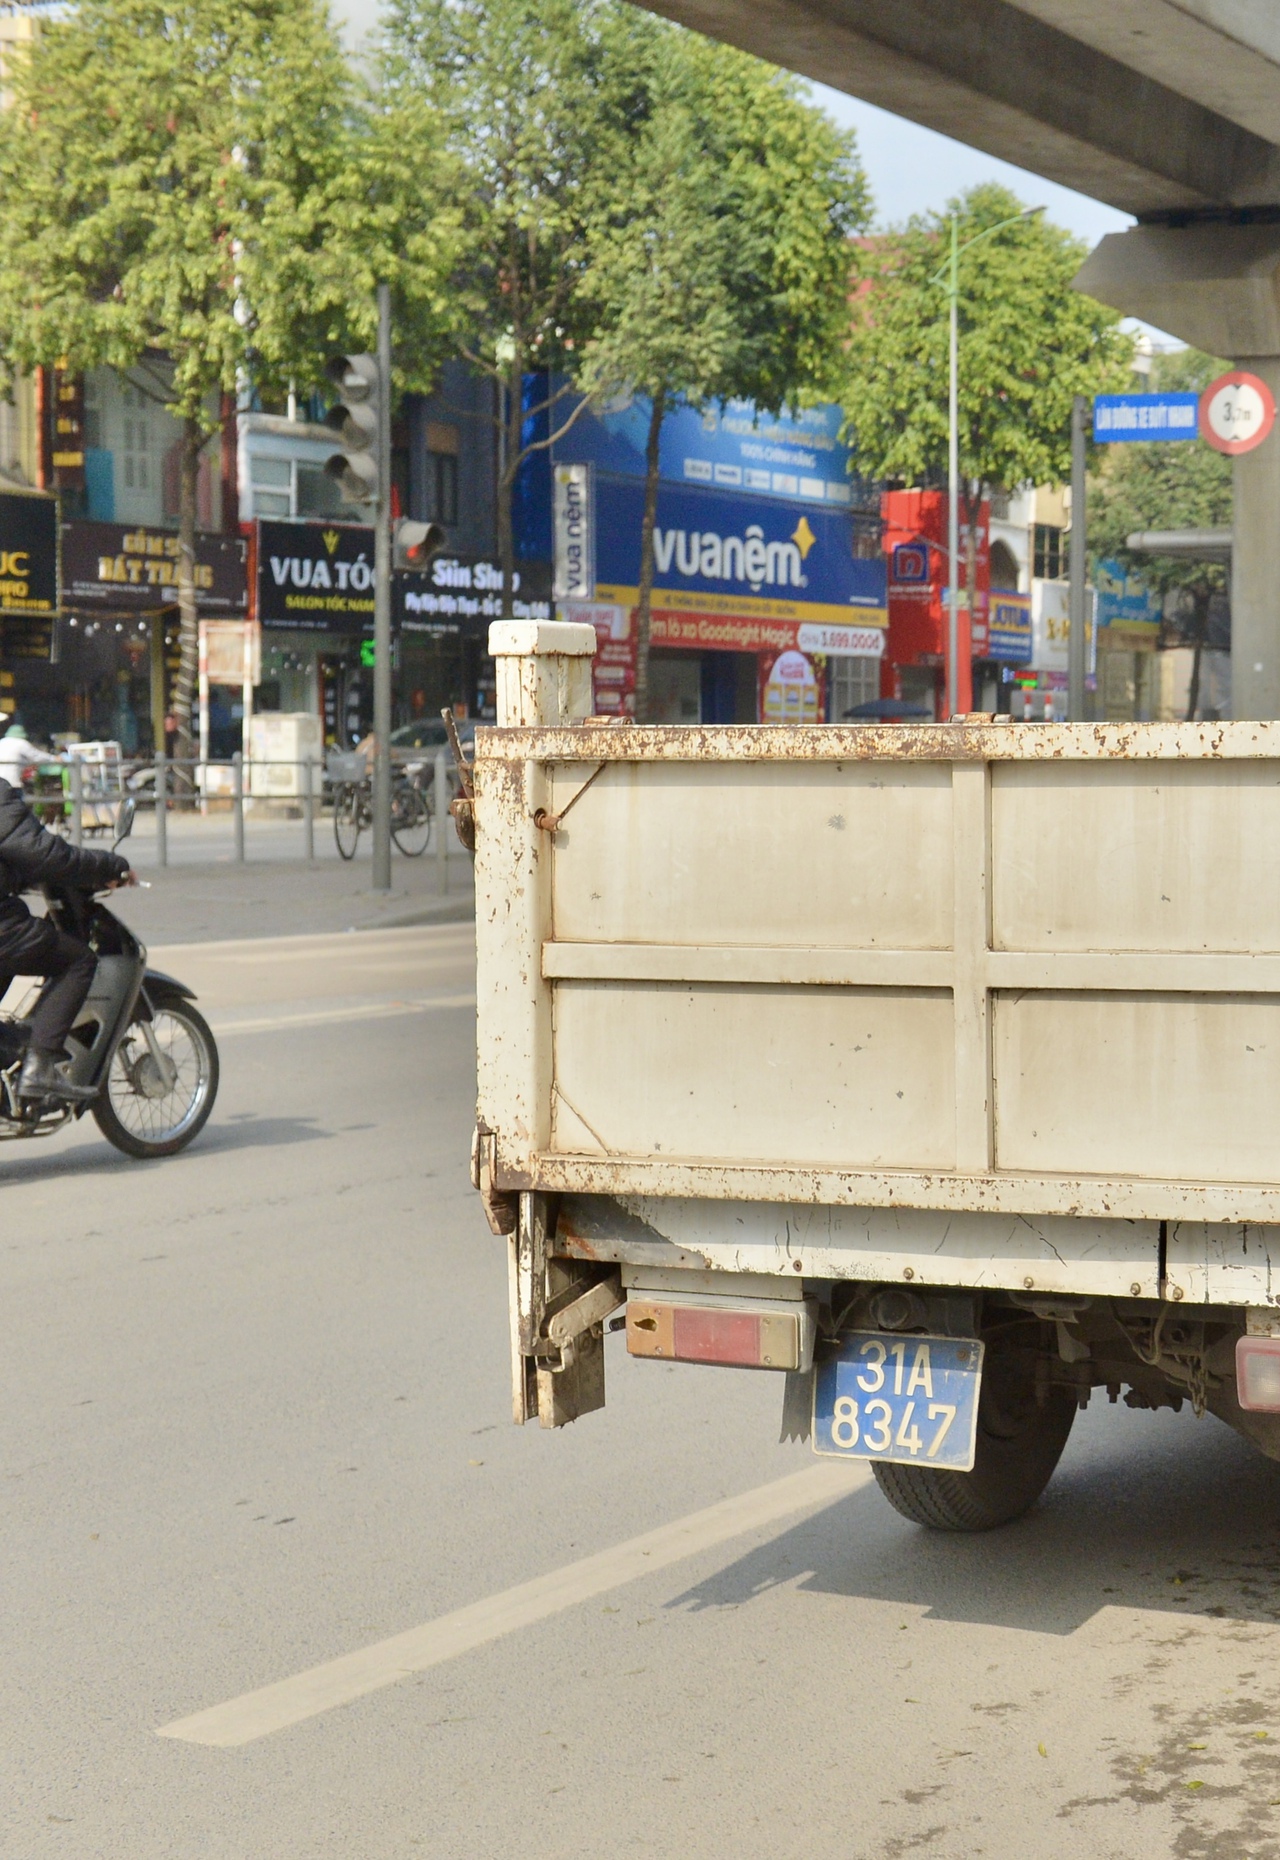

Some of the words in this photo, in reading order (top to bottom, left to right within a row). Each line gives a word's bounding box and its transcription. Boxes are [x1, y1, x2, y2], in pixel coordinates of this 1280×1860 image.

[98, 554, 143, 583] BÁT
[270, 555, 332, 588] VUA
[334, 553, 376, 591] TÓ
[567, 544, 582, 590] vua
[285, 594, 325, 610] SALON
[326, 594, 347, 612] TÓC
[699, 619, 760, 646] Goodnight
[761, 621, 795, 649] Magic
[857, 1340, 933, 1398] 31A
[831, 1396, 957, 1457] 8347
